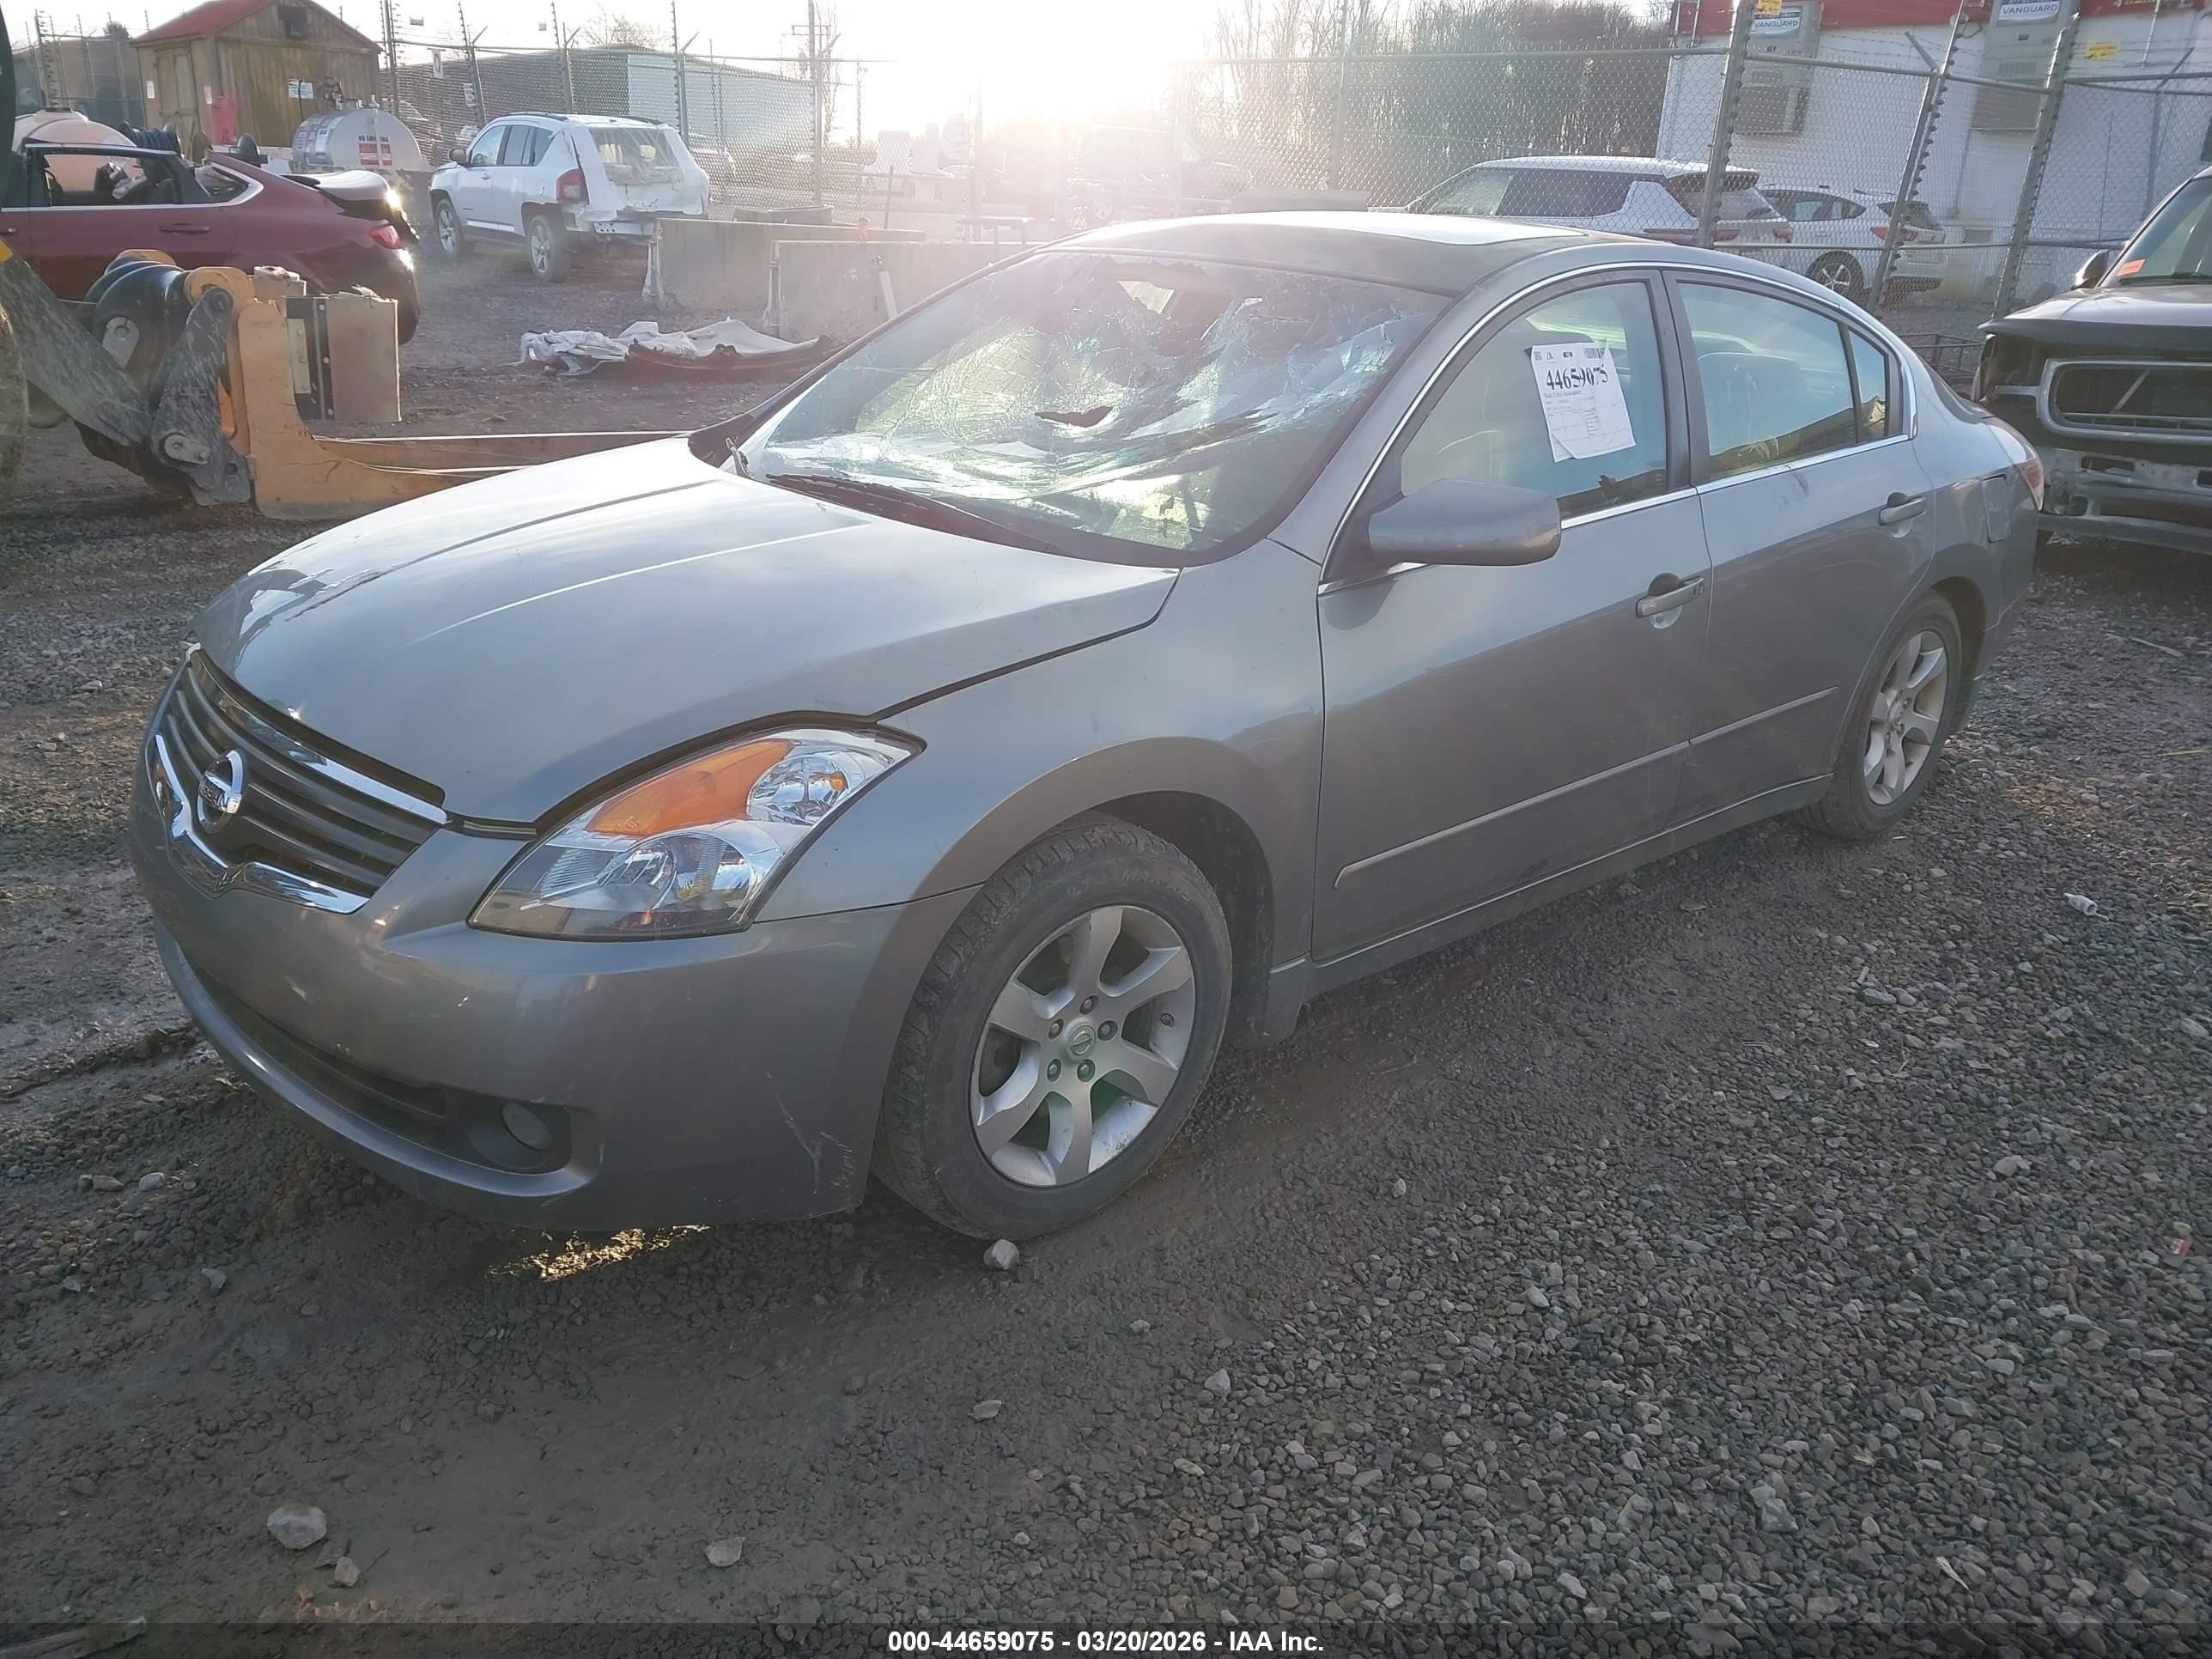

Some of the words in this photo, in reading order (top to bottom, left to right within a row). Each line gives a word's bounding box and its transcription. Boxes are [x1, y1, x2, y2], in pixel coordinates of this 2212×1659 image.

[2002, 4, 2058, 15] VANGUARD
[1754, 20, 1799, 28] VANGUARD
[1547, 364, 1608, 390] 44659075
